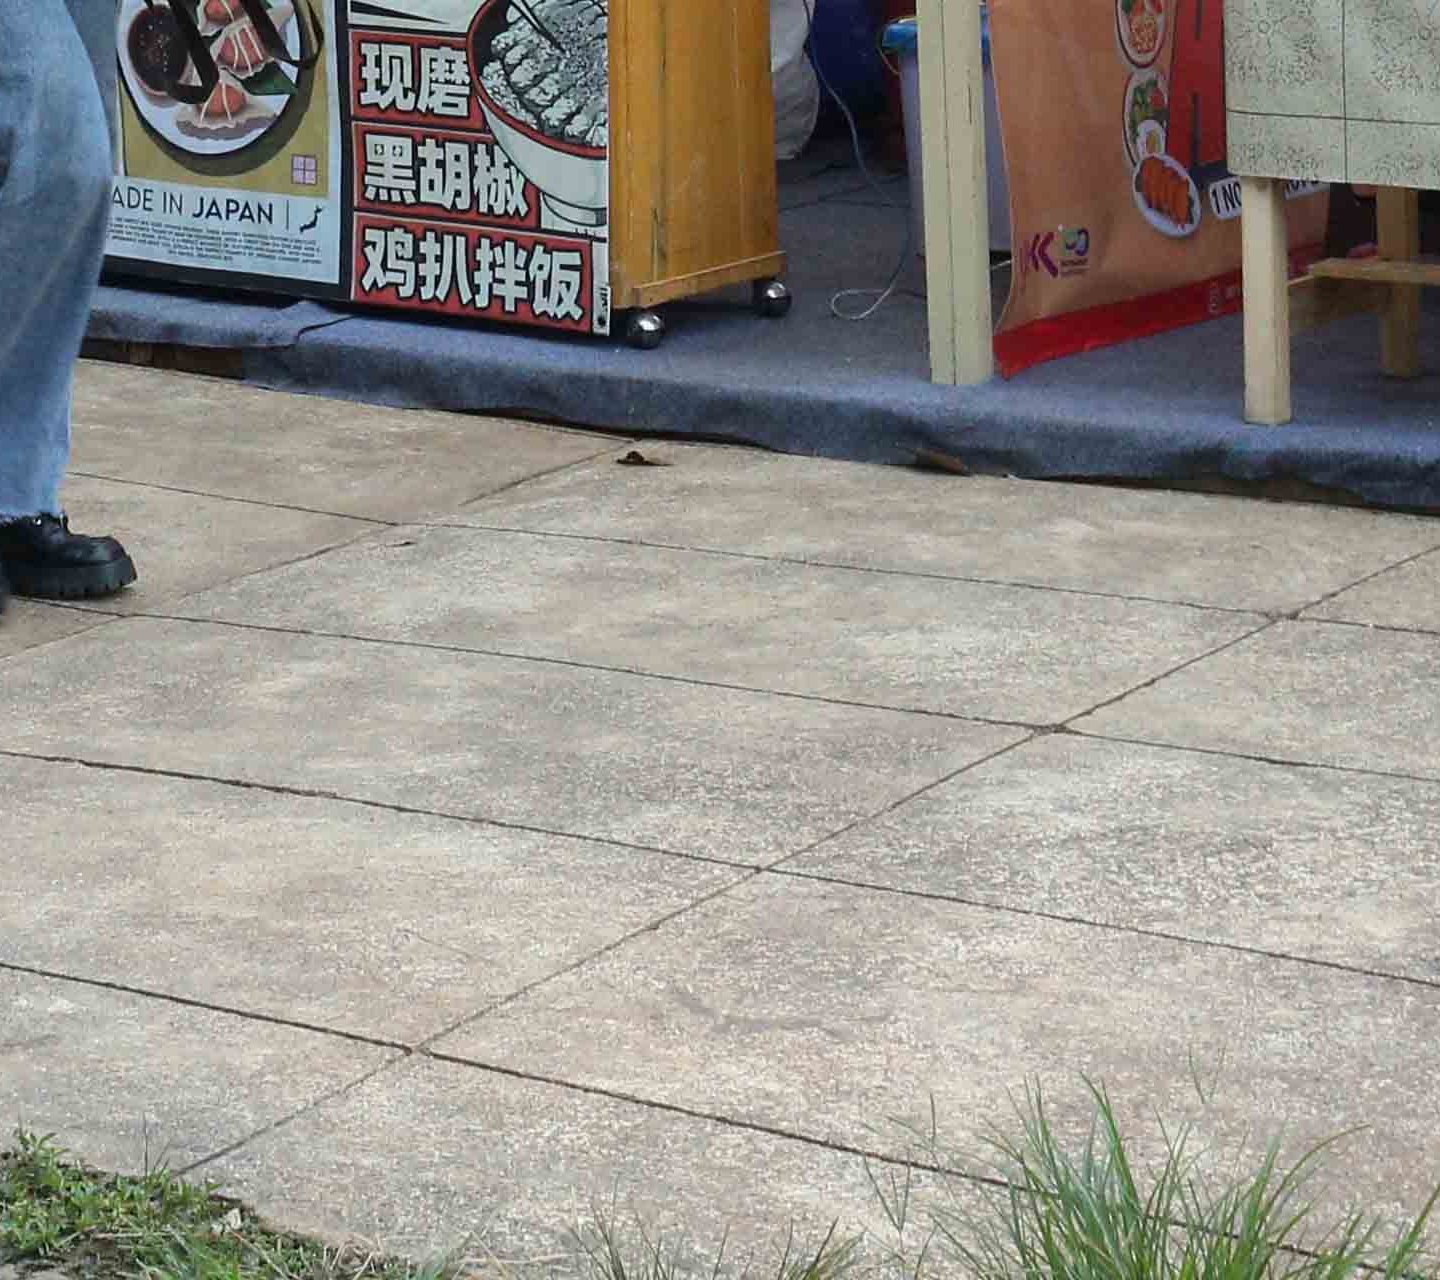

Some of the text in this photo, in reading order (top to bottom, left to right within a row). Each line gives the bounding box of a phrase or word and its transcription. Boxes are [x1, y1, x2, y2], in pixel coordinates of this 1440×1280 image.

[360, 43, 472, 118] 现磨
[112, 185, 274, 225] ADE IN JAPAN
[363, 133, 529, 218] 黑胡椒
[361, 226, 585, 321] 鸡扒拌饭
